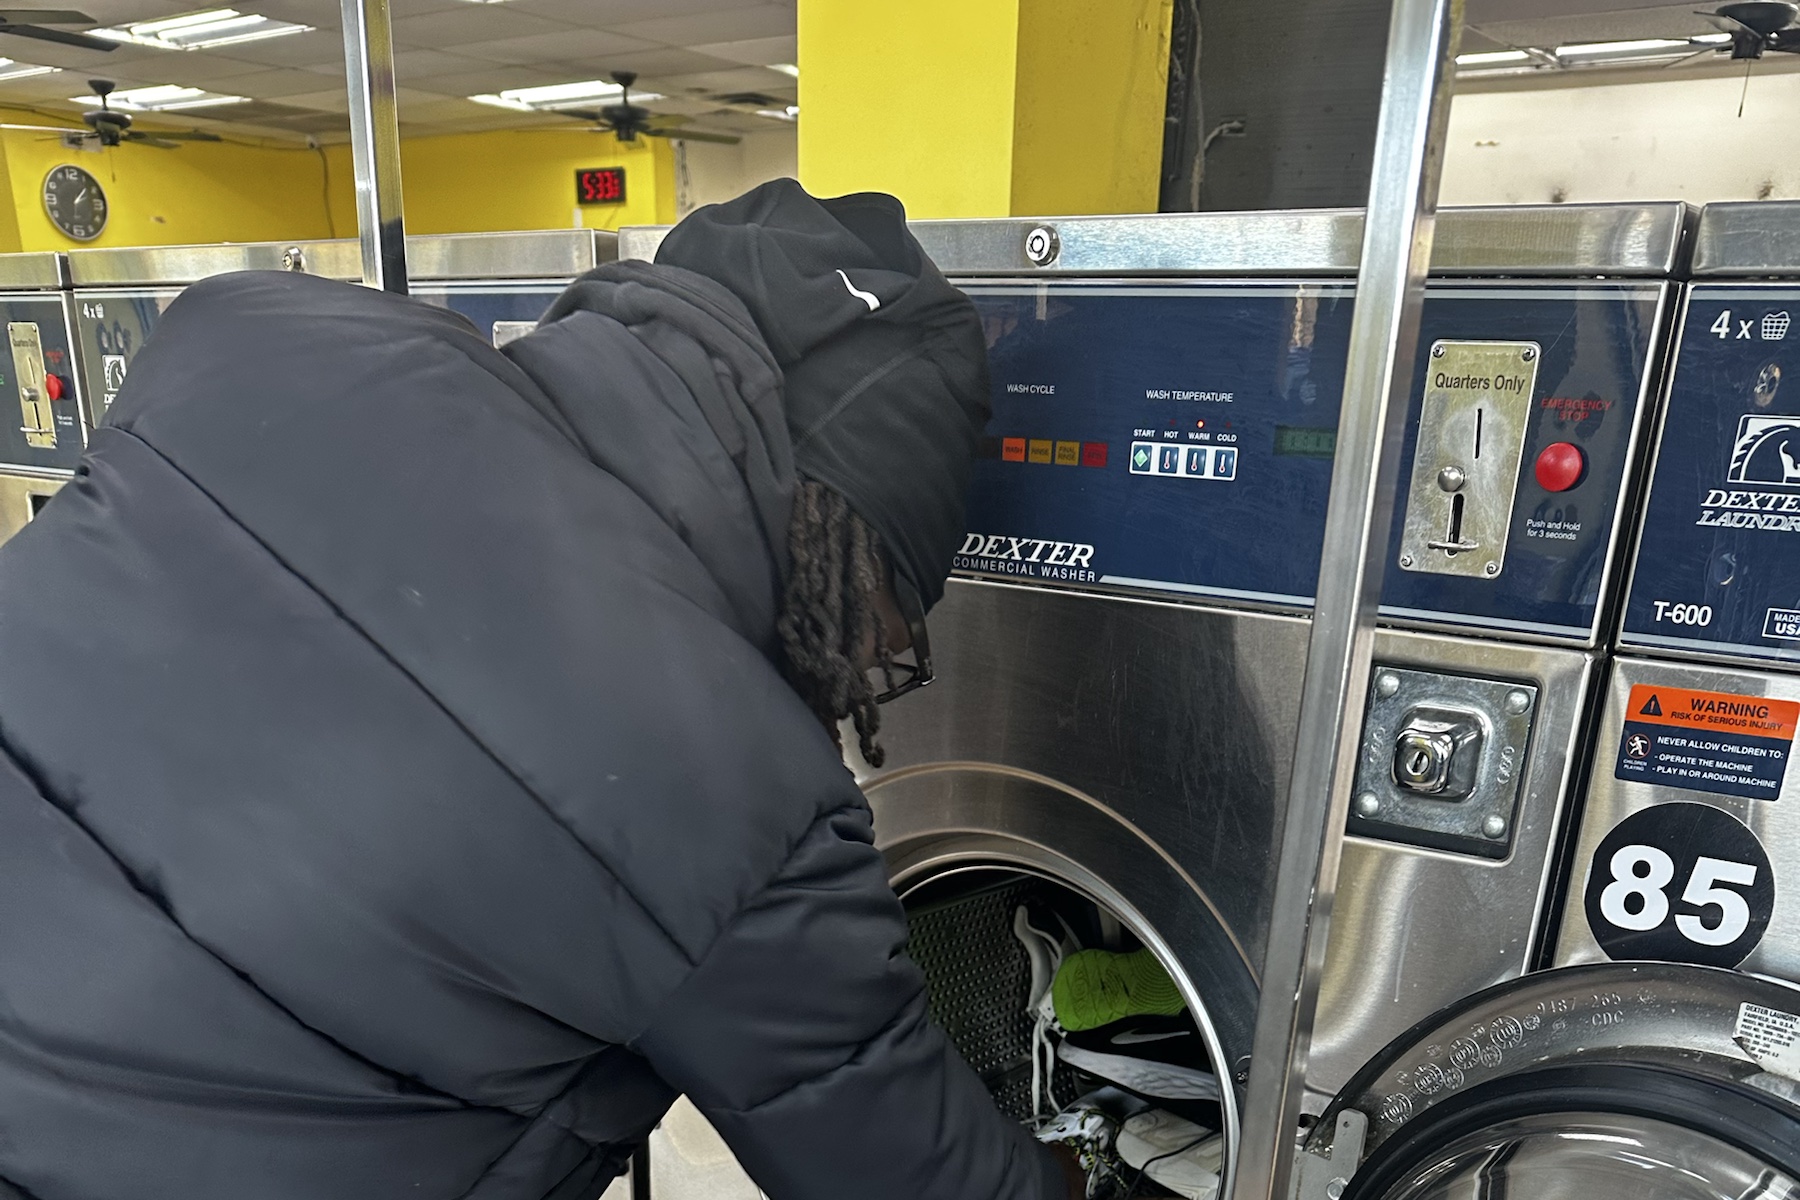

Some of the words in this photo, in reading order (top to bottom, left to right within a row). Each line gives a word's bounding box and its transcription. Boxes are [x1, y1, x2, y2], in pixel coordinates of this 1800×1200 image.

[1710, 310, 1731, 339] 4
[1006, 383, 1029, 394] WASH
[1029, 384, 1056, 395] CYCLE
[1435, 372, 1490, 390] Quarters
[1494, 374, 1526, 395] Only
[1145, 389, 1170, 400] WASH
[1171, 390, 1234, 403] TEMPERATURE
[1541, 397, 1612, 412] EMERGENCY
[1558, 409, 1590, 422] STOP
[1133, 428, 1156, 438] START
[1163, 431, 1179, 439] HOT
[1187, 432, 1211, 441] WARM
[1217, 433, 1238, 443] COLD
[1700, 489, 1800, 513] DEXTE
[1526, 518, 1546, 528] Push
[1546, 521, 1562, 529] and
[1562, 522, 1581, 531] Hold
[1527, 528, 1538, 537] for
[1538, 529, 1545, 538] 3
[1545, 531, 1577, 540] seconds
[957, 532, 1095, 568] DEXTER
[952, 556, 1035, 576] COMMERCIAL
[1041, 566, 1095, 582] WASHER
[1653, 600, 1713, 627] T-600
[1691, 698, 1769, 718] WARNING
[1671, 711, 1691, 720] RISK
[1693, 713, 1706, 721] OF
[1708, 715, 1747, 727] SERIOUS
[1749, 720, 1782, 731] INJURY
[1657, 736, 1687, 747] NEVER
[1688, 740, 1721, 751] ALLOW
[1721, 744, 1767, 757] CHILDREN
[1768, 749, 1784, 759] TO:
[1659, 753, 1696, 765] OPERATE
[1698, 758, 1714, 767] THE
[1715, 760, 1753, 773] MACHINE
[1656, 765, 1678, 775] PLAY
[1688, 769, 1701, 778] OR
[1702, 771, 1737, 783] AROUND
[1738, 775, 1777, 788] MACHINE
[1600, 844, 1757, 946] 85
[1745, 1004, 1769, 1015] DEXTER
